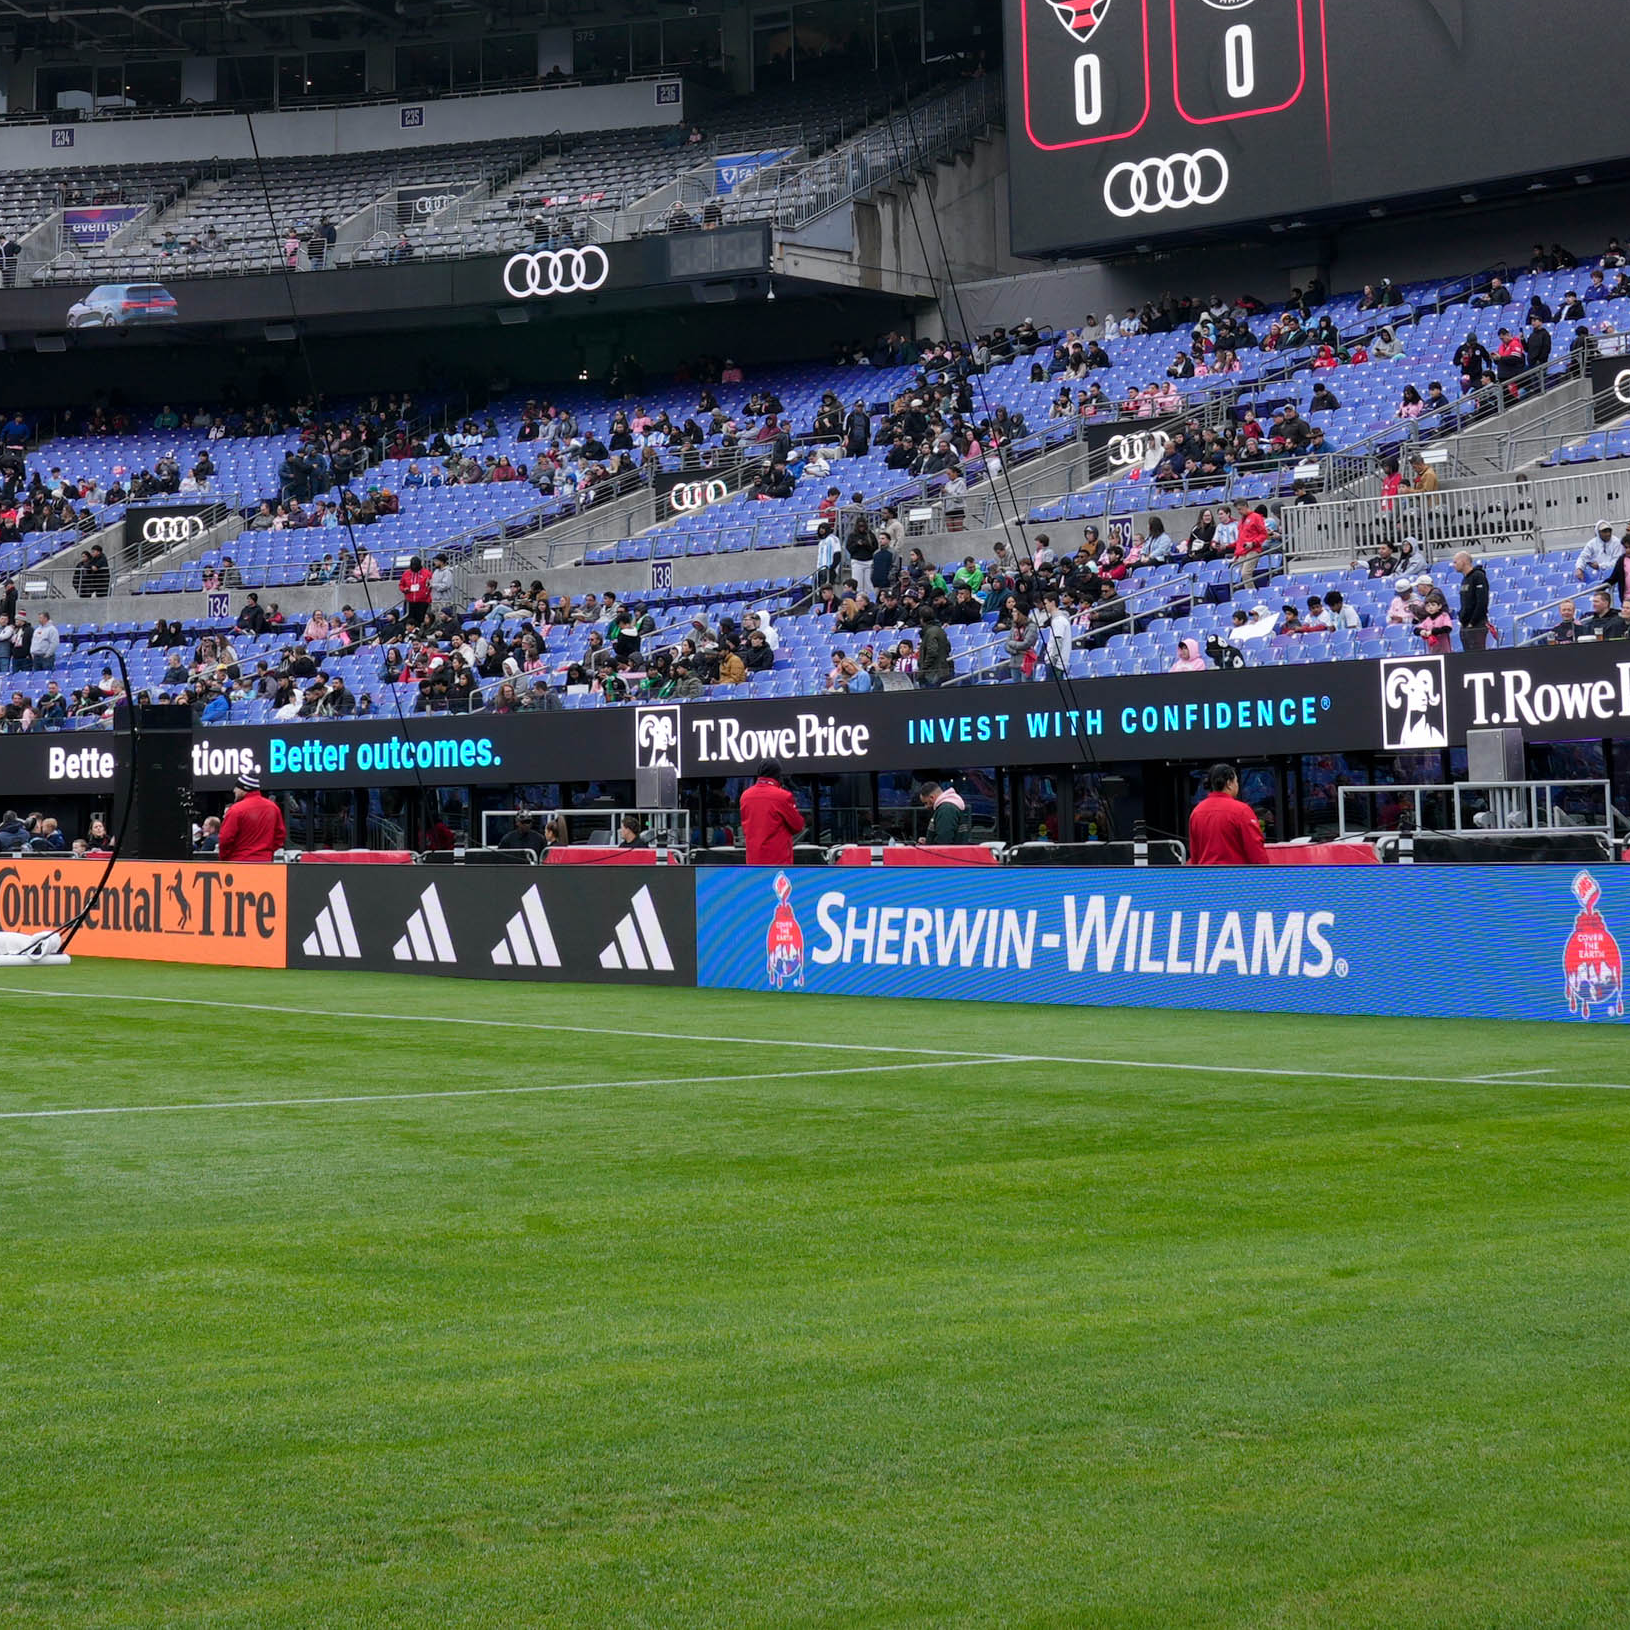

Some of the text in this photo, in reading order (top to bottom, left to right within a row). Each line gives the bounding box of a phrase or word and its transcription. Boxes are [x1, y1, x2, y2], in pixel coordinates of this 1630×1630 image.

[1224, 23, 1254, 99] 0
[1073, 53, 1102, 126] 0
[55, 131, 70, 145] 234
[652, 567, 671, 588] 138
[907, 714, 1010, 746] INVEST
[1027, 707, 1104, 739] WITH
[49, 736, 501, 779] Bette tions. Better outcomes.
[193, 870, 276, 939] Tire
[1578, 934, 1604, 942] COVER
[1584, 942, 1599, 950] THE
[1578, 950, 1605, 958] EARTH
